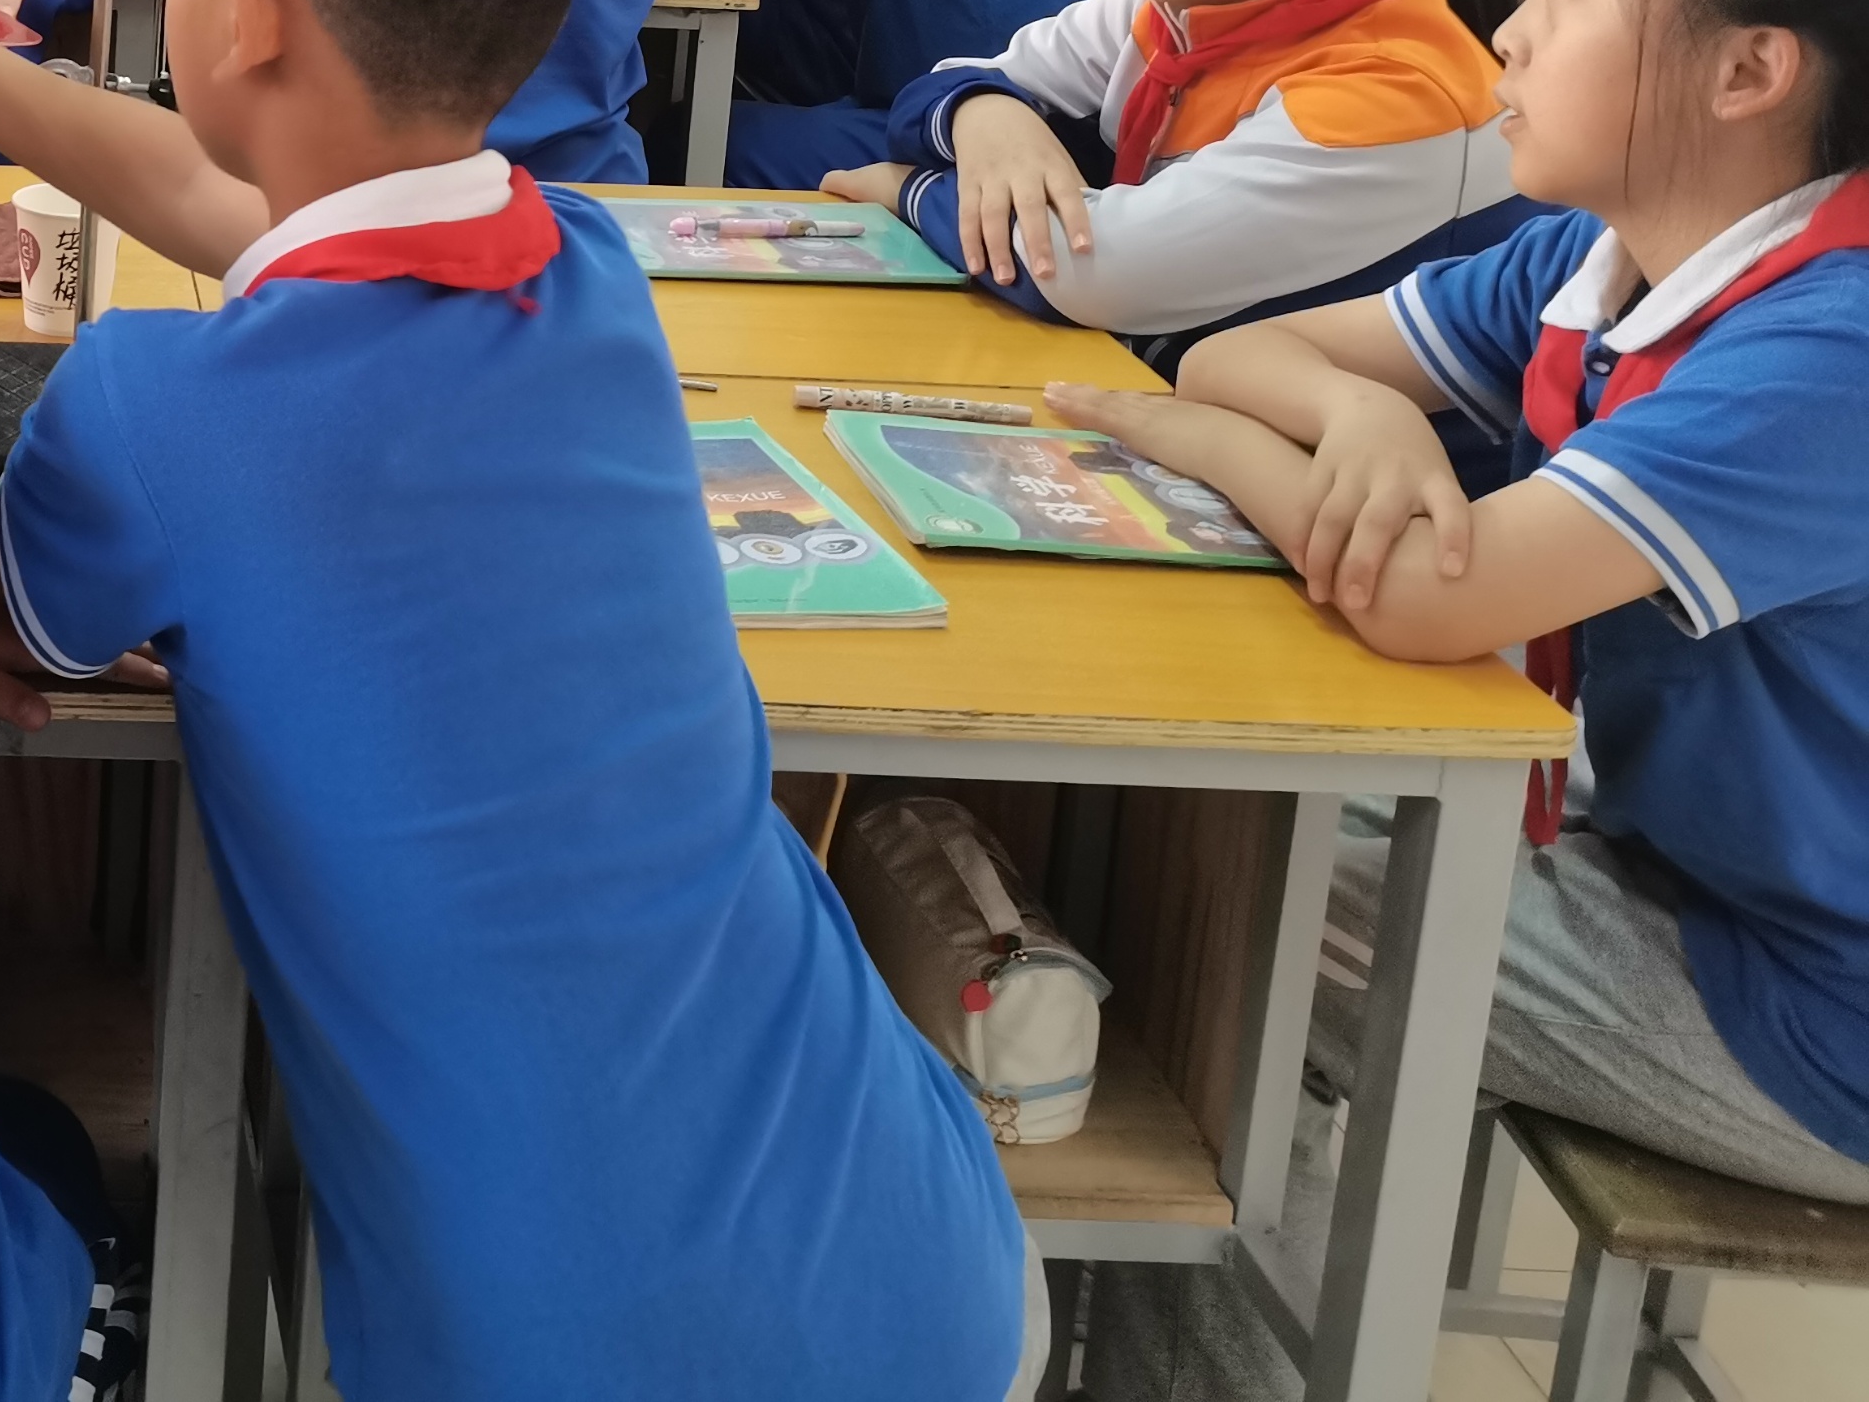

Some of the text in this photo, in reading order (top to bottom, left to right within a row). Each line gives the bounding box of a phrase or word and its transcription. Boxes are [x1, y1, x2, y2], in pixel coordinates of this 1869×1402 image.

[20, 232, 31, 271] CUP
[1019, 444, 1059, 475] KEXUE
[707, 490, 787, 503] KEXUE
[1010, 474, 1110, 526] 科学
